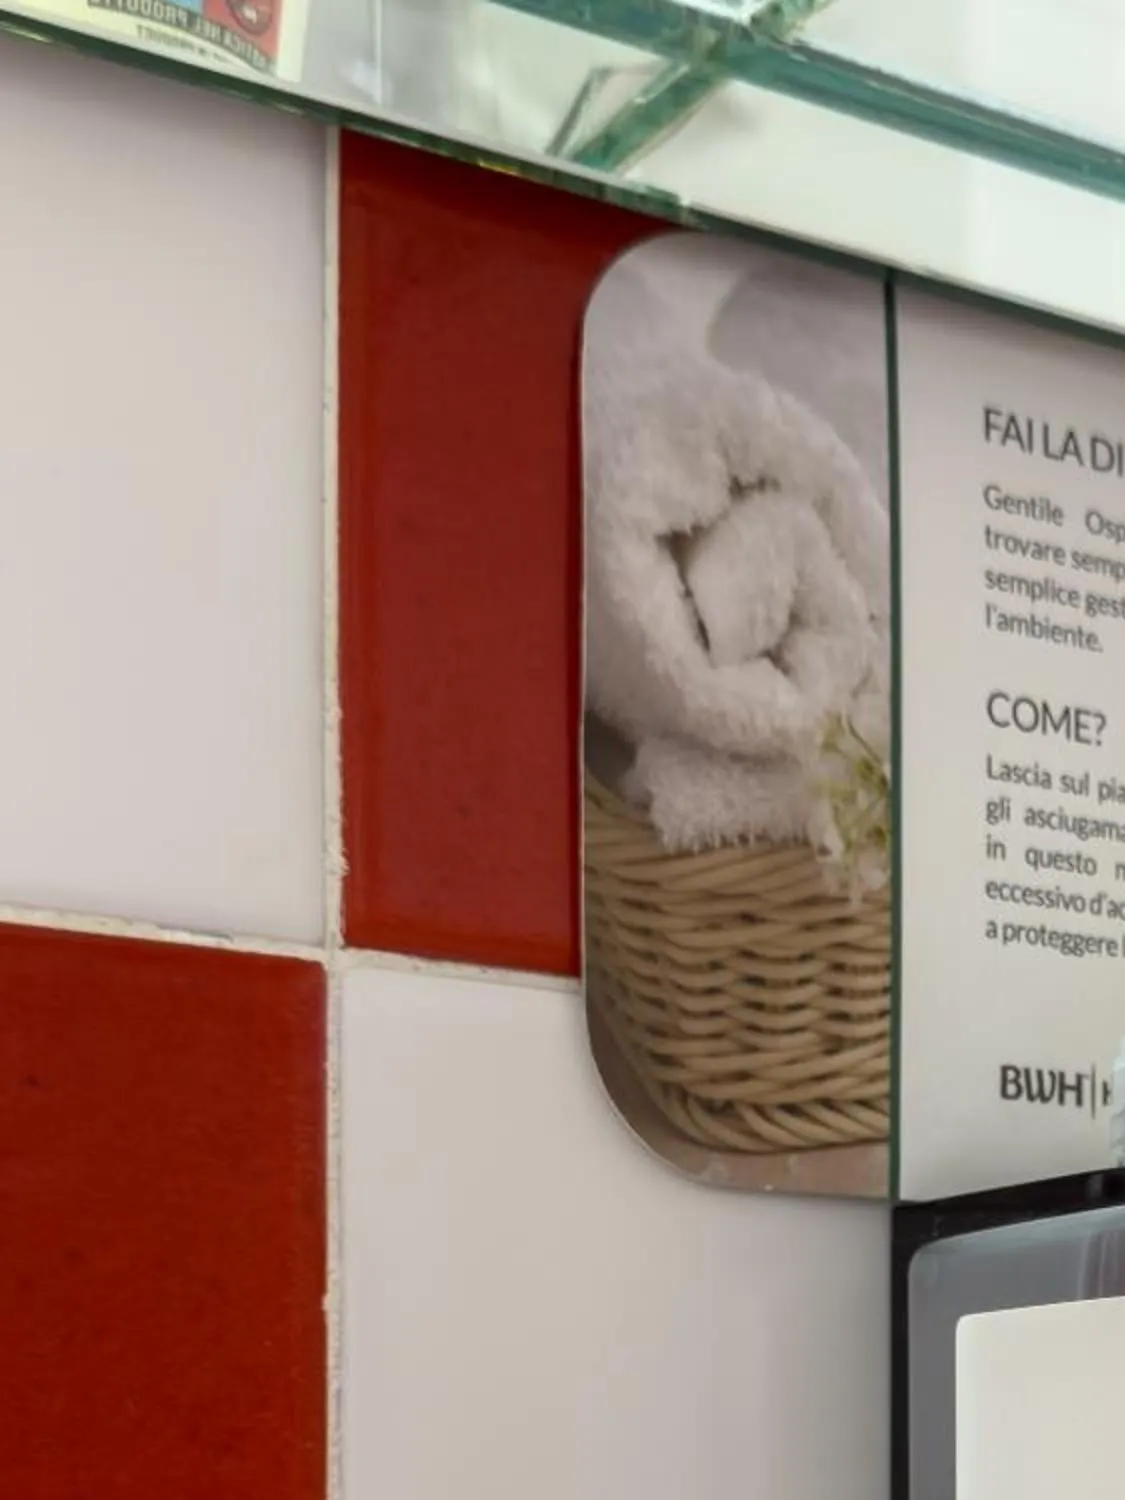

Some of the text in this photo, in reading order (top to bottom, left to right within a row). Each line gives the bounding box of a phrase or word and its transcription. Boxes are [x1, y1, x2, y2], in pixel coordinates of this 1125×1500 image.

[983, 407, 1033, 454] FAI
[1042, 425, 1084, 467] LA
[982, 483, 1064, 527] Gentile
[985, 525, 1066, 566] trovare
[984, 567, 1081, 609] semplice
[985, 603, 1103, 653] l'ambiente.
[986, 691, 1107, 747] COME?
[986, 754, 1053, 790] Lascia
[1059, 771, 1090, 798] sul
[986, 799, 1012, 825] gli
[986, 834, 1006, 861] in
[1025, 845, 1098, 879] questo
[985, 879, 1085, 913] eccessivo
[985, 923, 999, 941] a
[1002, 920, 1119, 958] proteggere
[1000, 1064, 1085, 1107] BWH
